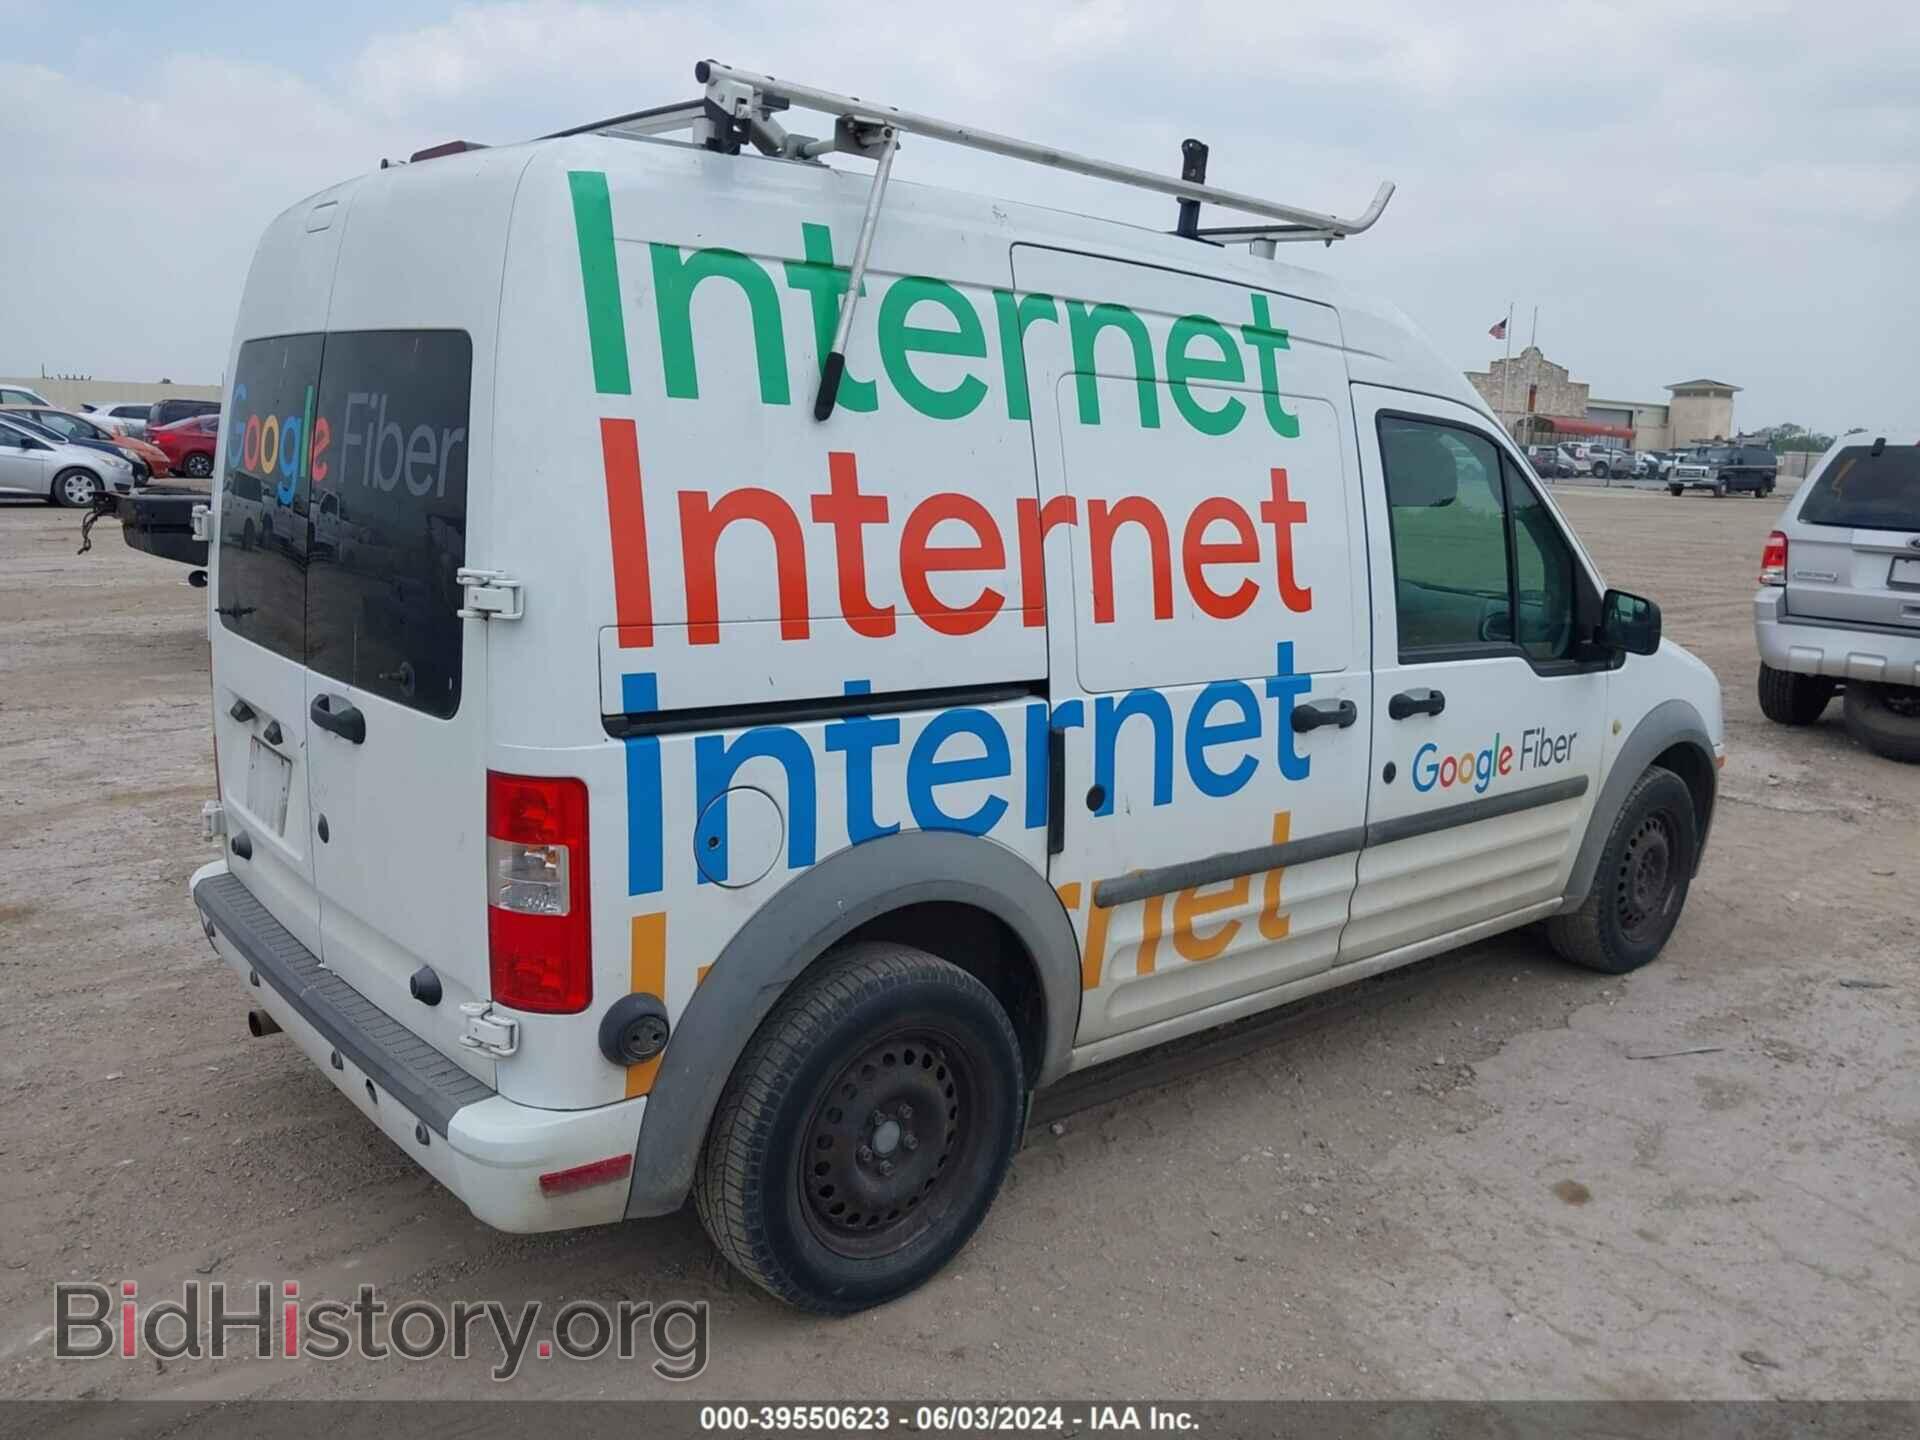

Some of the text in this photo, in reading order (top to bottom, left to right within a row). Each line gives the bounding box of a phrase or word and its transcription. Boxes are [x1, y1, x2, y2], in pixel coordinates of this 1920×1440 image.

[567, 170, 1301, 439] Internet
[227, 383, 466, 506] Google Fiber
[600, 417, 1313, 648] Internet
[621, 641, 1312, 897] Internet
[1412, 727, 1578, 794] Google Fiber
